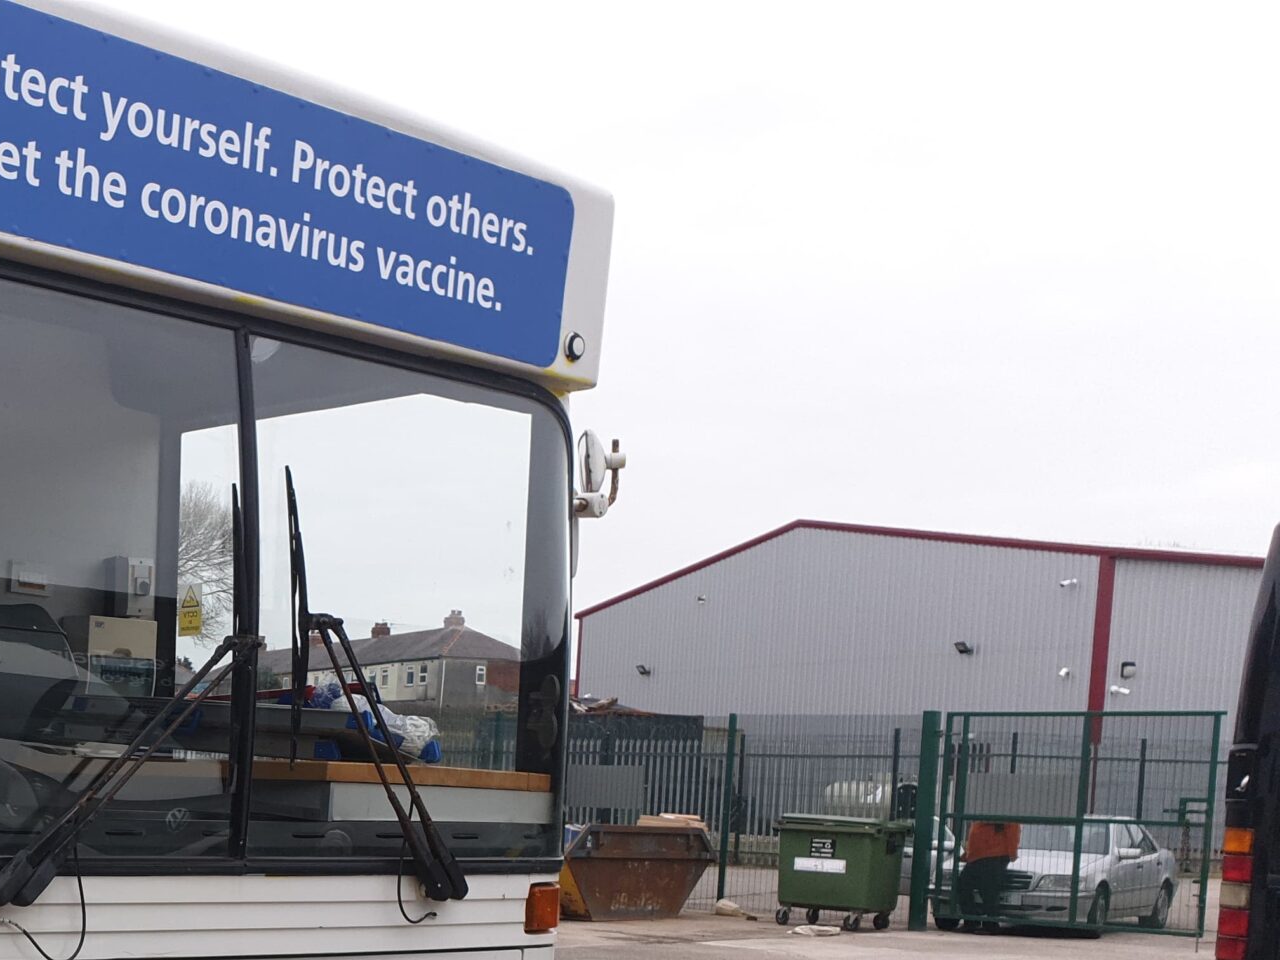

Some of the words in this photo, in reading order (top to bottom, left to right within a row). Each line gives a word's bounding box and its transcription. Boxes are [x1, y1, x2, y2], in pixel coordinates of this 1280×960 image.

[55, 146, 127, 209] the
[140, 180, 365, 273] coronavirus
[376, 245, 503, 312] vaccine.
[99, 91, 278, 177] yourself.
[291, 139, 417, 220] Protect
[425, 191, 534, 256] others.
